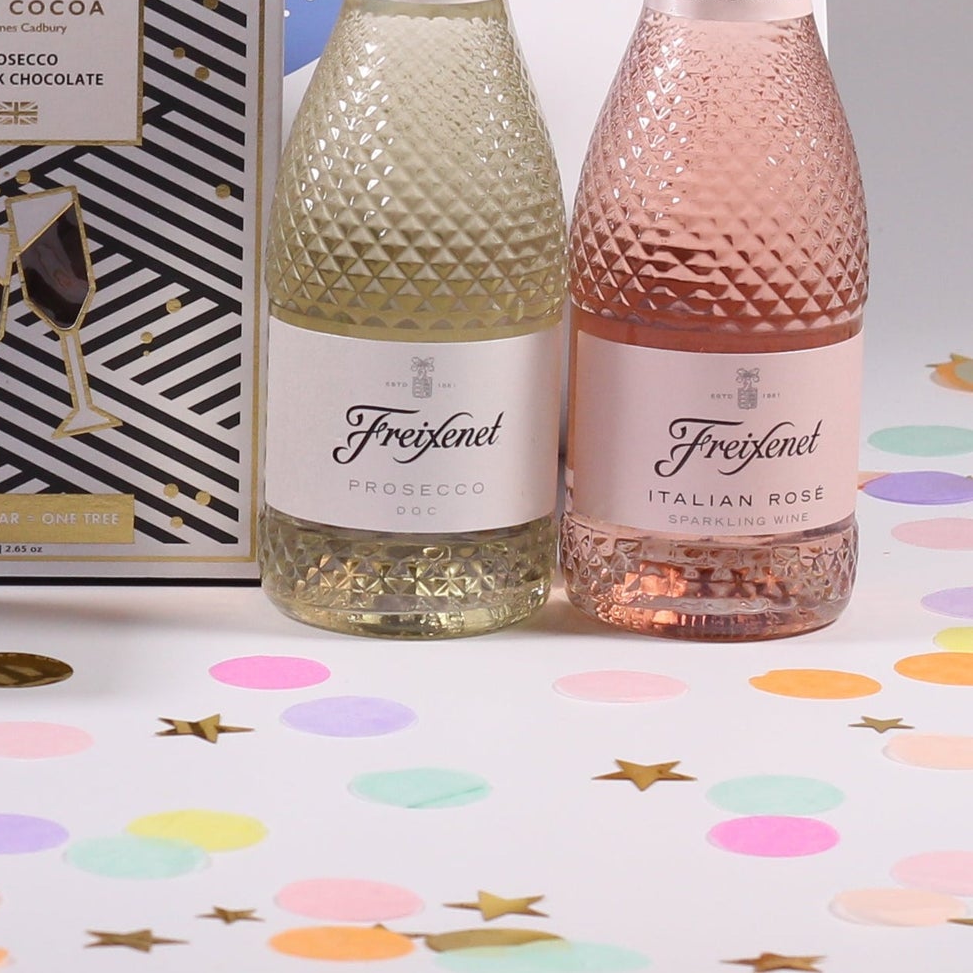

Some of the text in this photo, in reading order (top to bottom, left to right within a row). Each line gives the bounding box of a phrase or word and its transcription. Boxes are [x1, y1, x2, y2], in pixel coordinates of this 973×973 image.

[9, 0, 105, 16] COCOA
[21, 23, 67, 35] Cadbury
[10, 73, 104, 86] CHOCOLATE
[332, 404, 505, 465] Freixenet
[654, 417, 823, 478] Freixenet
[349, 479, 485, 497] PROSECCO
[649, 484, 825, 508] ITALIAN ROSÉ
[42, 512, 76, 525] ONE
[83, 512, 120, 525] TREE
[396, 506, 437, 516] DOC
[668, 512, 809, 527] SPARKLING WINE
[5, 544, 27, 553] 2.65
